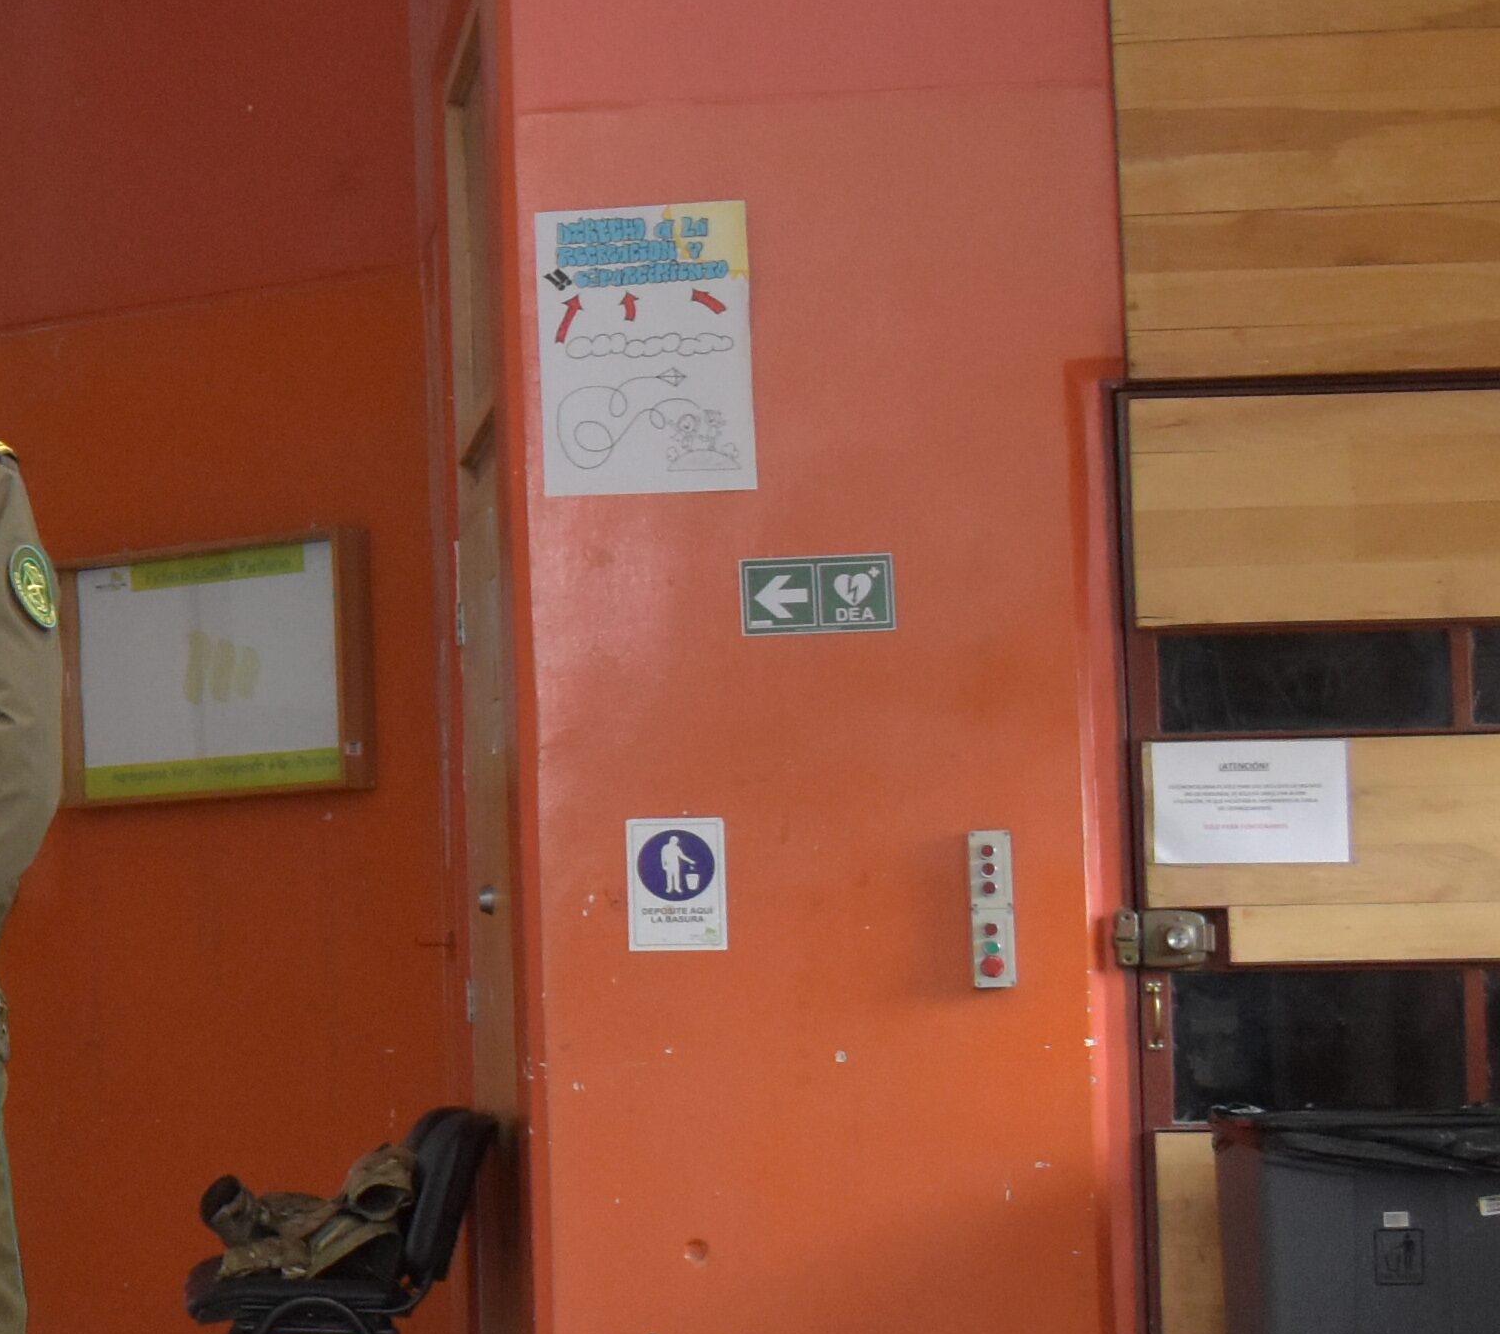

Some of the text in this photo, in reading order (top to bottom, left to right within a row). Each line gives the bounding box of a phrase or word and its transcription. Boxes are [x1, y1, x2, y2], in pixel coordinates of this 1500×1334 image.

[835, 606, 876, 622] DEA
[650, 915, 704, 924] LA BASURA
